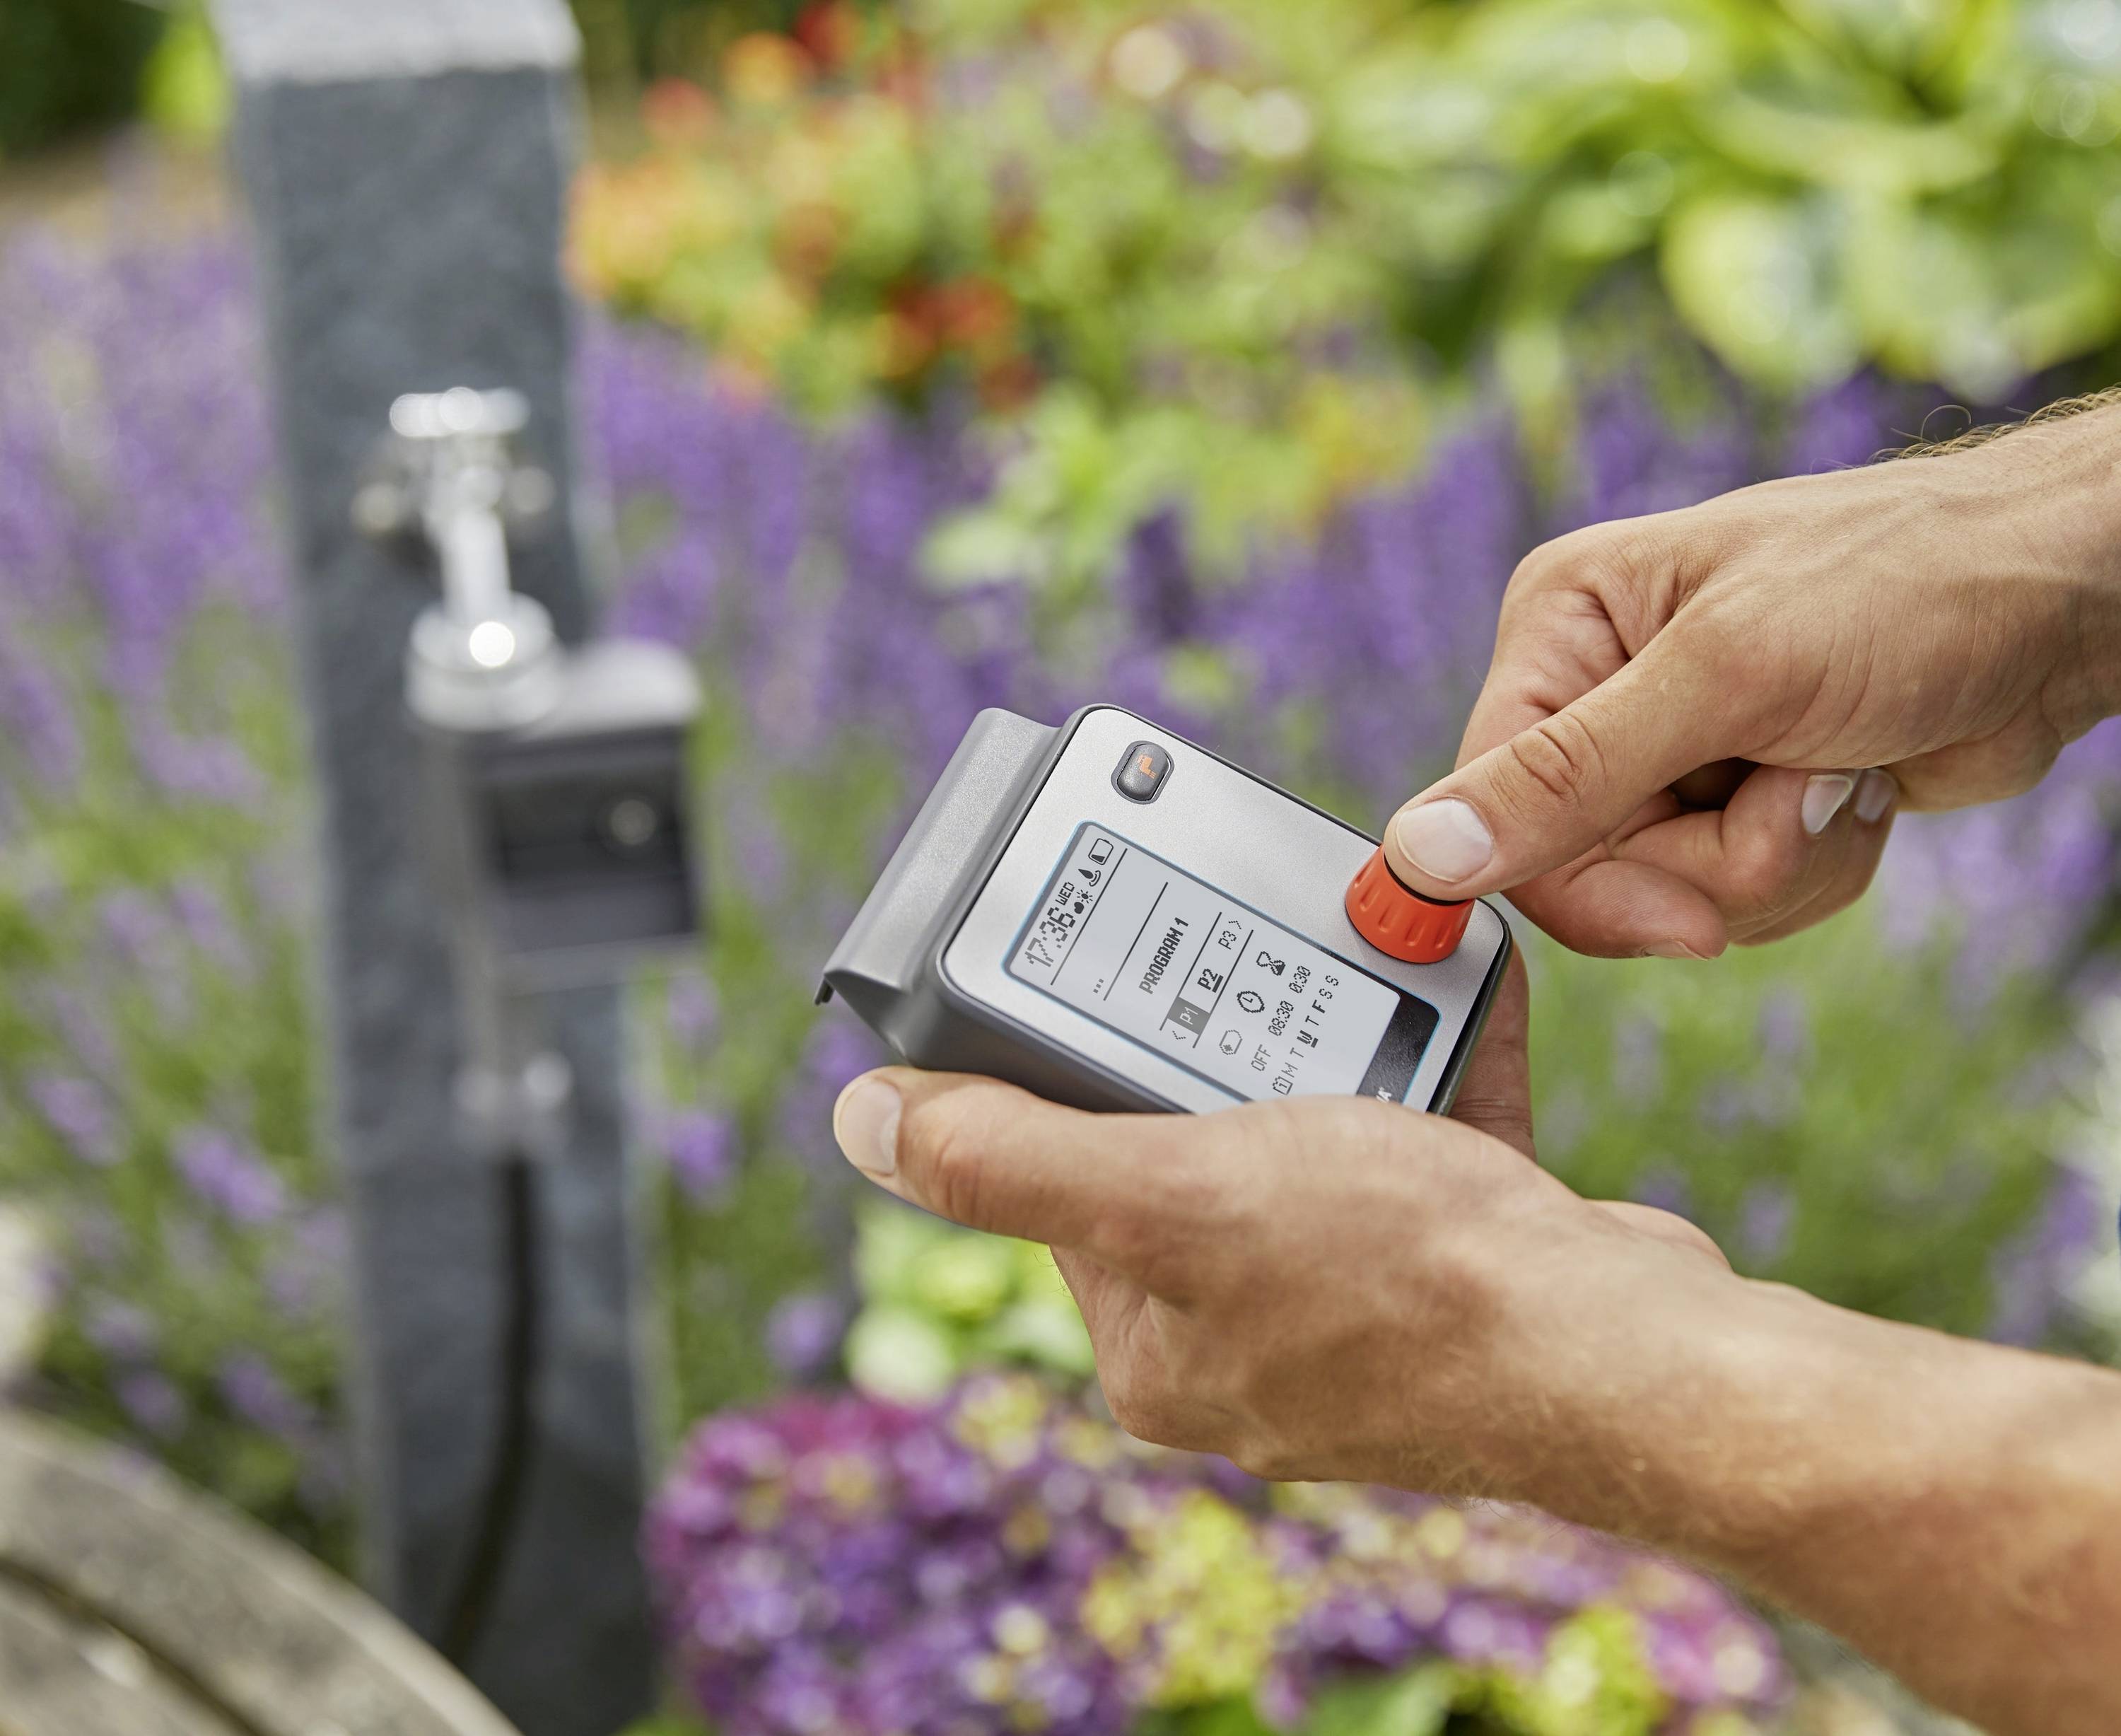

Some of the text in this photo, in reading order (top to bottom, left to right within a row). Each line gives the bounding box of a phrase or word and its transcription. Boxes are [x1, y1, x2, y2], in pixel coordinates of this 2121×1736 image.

[1025, 882, 1075, 967] 17:36 WED
[1139, 917, 1188, 994] PROGRAM 1
[1179, 931, 1237, 1025] P1 P2 P3
[1251, 966, 1311, 1071] OFF 08:30 0:30
[1281, 975, 1339, 1078] M T W T F S S
